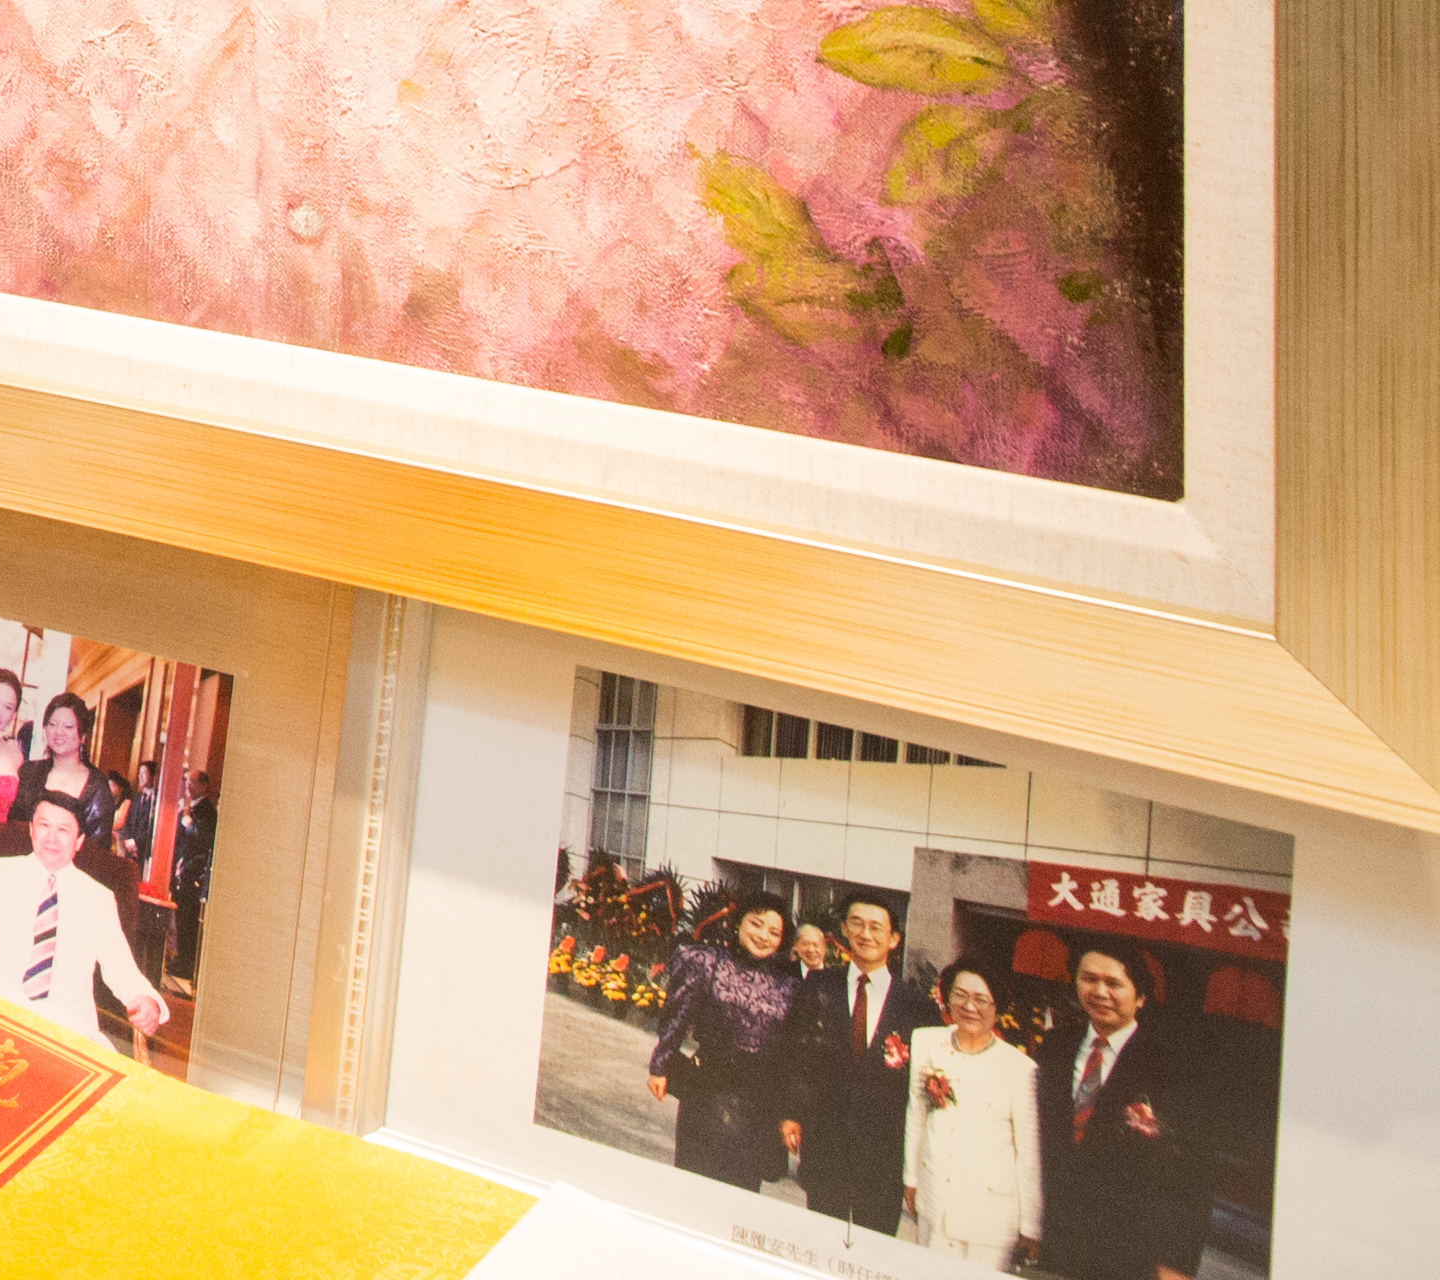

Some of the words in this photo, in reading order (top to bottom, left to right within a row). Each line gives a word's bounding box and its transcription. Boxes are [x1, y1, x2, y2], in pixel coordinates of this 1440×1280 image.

[1047, 871, 1291, 943] 大通家具公
